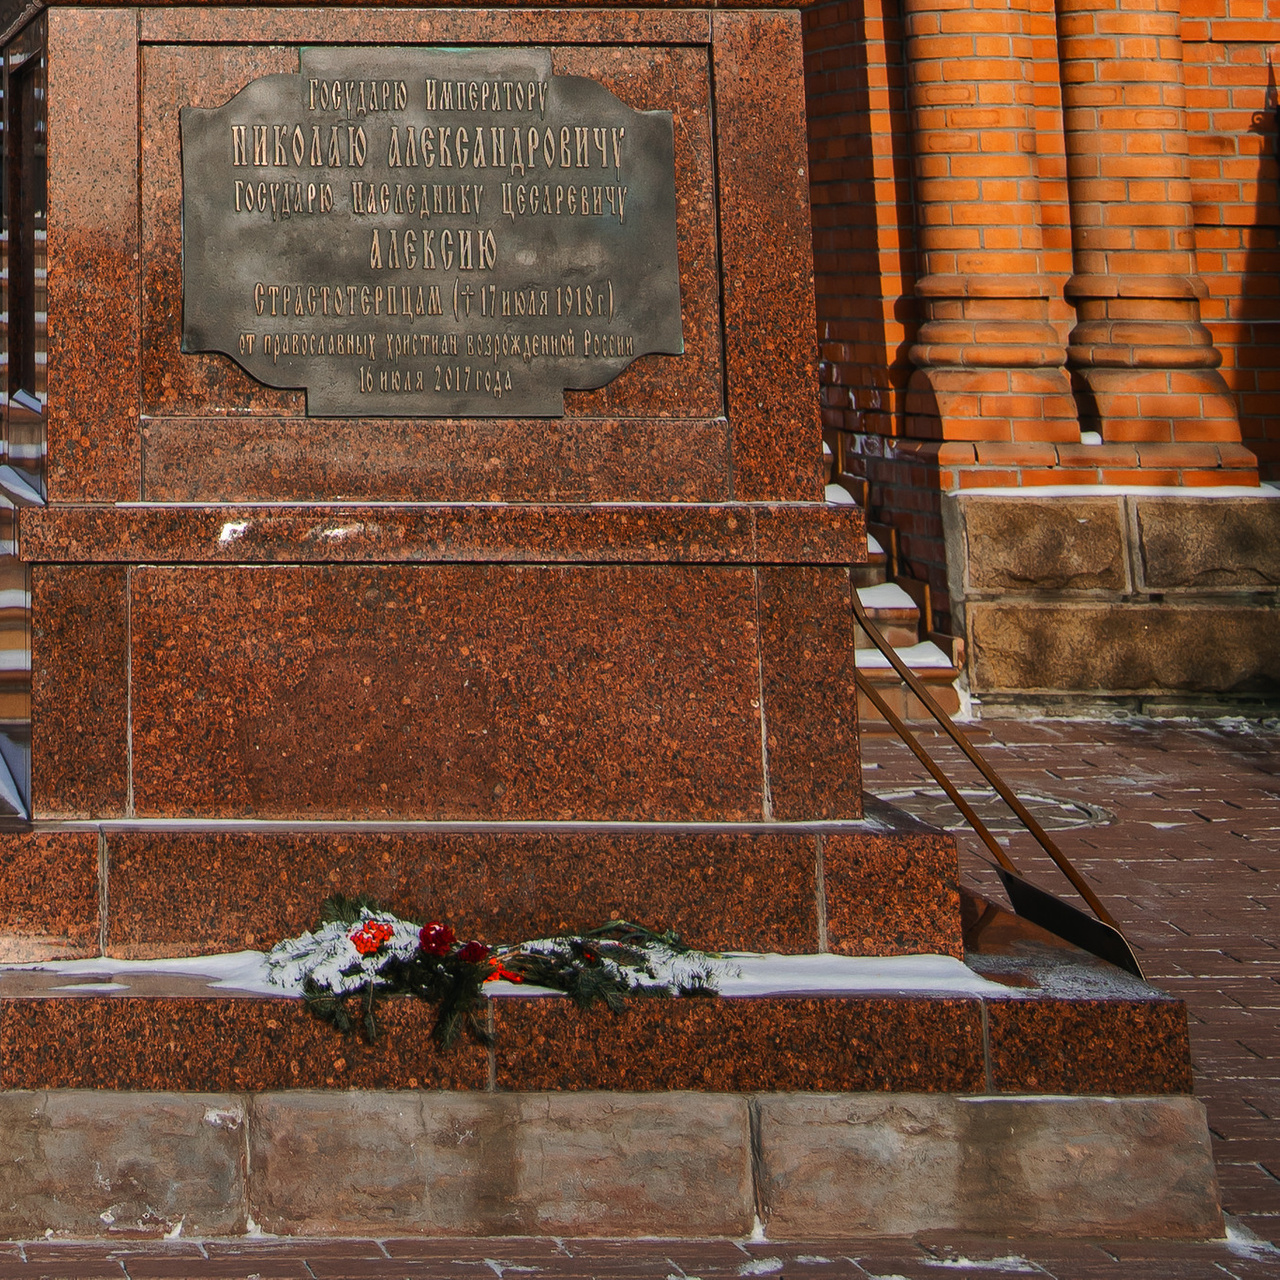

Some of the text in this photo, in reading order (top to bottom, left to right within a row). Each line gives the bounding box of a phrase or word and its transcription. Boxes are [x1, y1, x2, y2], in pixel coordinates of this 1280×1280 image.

[231, 124, 626, 181] НИКОЛАЮ АЛЕКСАНДРОВИЧУ
[369, 228, 499, 271] АЛЕКСИЮ
[502, 290, 549, 316] июля
[556, 284, 593, 316] 1918
[239, 329, 634, 364] от православных христиан возрожденной России
[359, 365, 512, 398] 16 июля 2017 года
